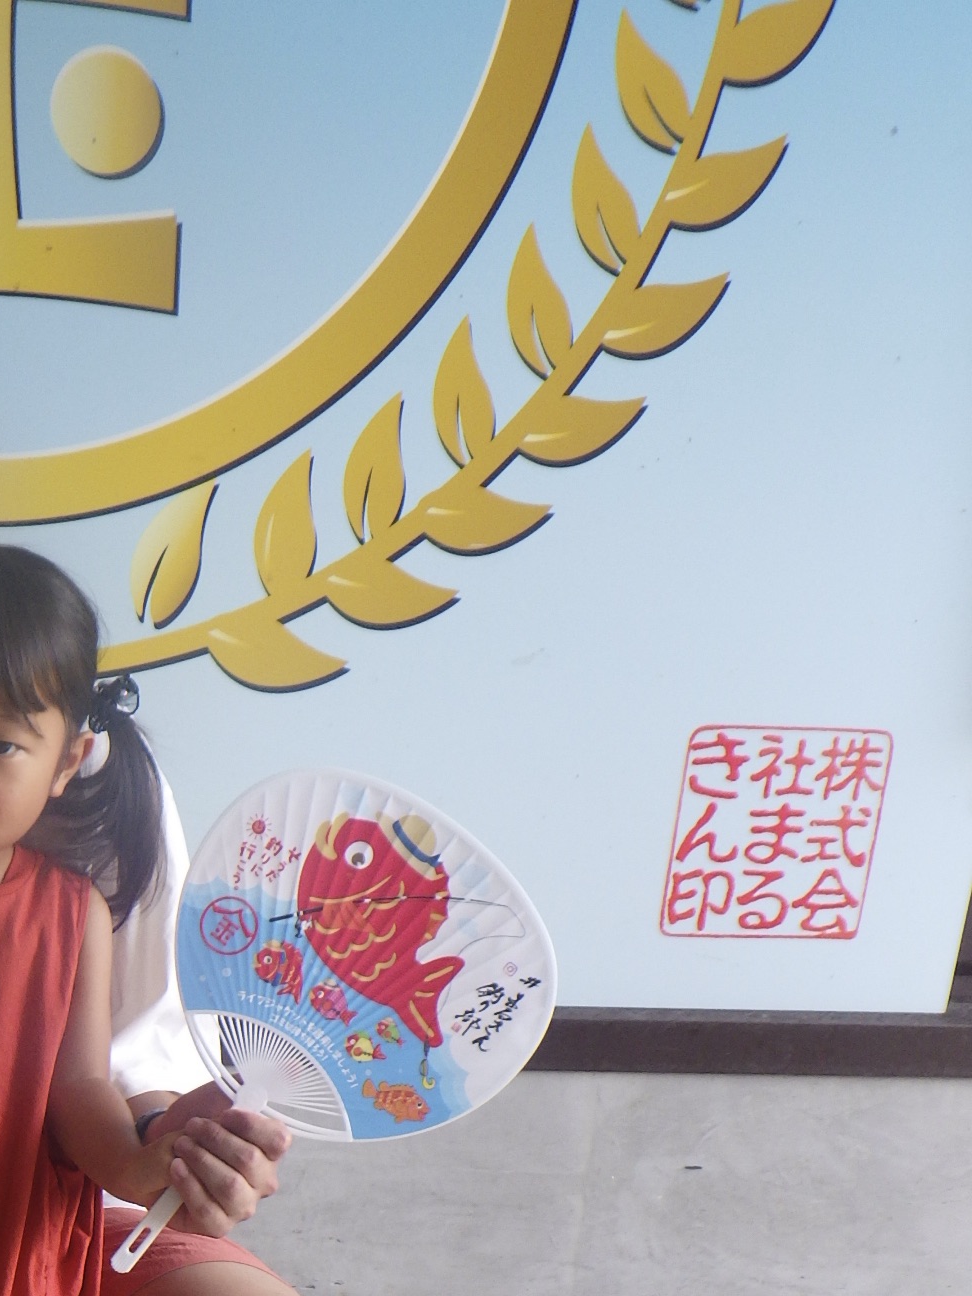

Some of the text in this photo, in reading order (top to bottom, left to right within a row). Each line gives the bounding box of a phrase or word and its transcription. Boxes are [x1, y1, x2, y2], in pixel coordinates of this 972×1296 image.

[250, 836, 284, 878] 釣りに
[265, 846, 302, 883] そうだ
